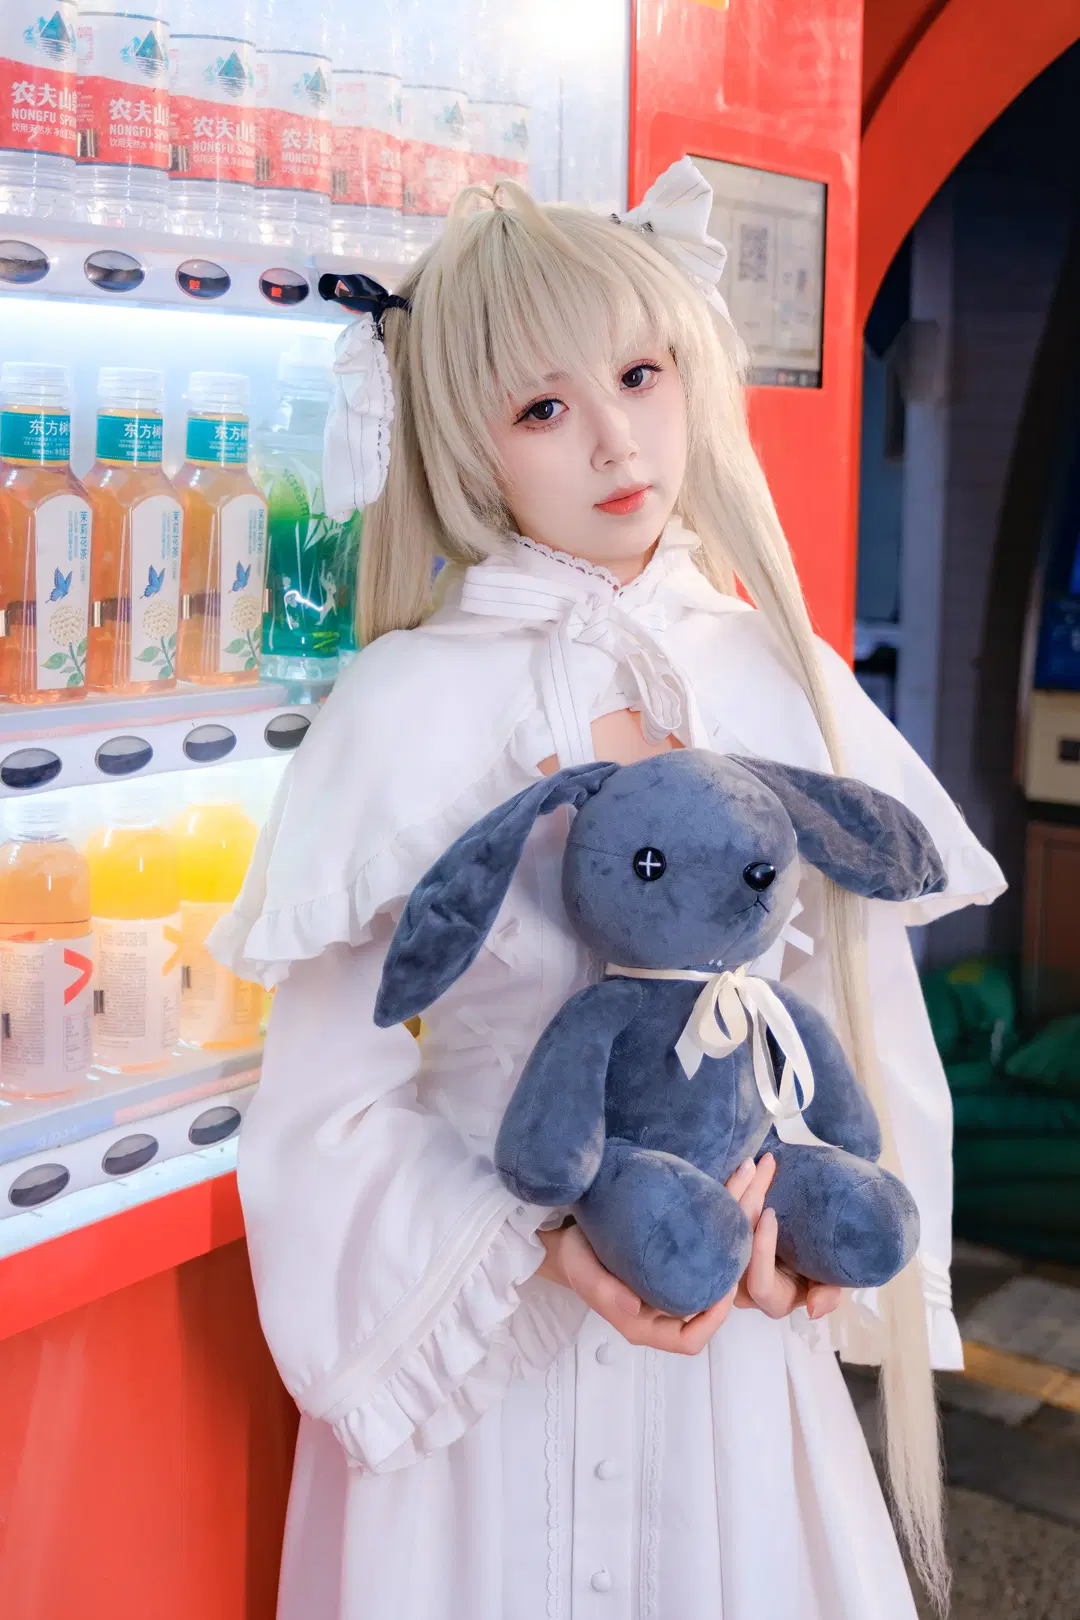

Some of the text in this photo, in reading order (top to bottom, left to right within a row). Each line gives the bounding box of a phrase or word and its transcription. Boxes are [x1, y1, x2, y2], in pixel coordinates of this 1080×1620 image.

[11, 107, 57, 124] NONGFU
[109, 97, 169, 127] 农夫山
[109, 124, 152, 139] NONGFU
[282, 126, 331, 154] 农夫山
[192, 141, 234, 155] NONGFU
[283, 468, 310, 517] scream
[80, 511, 88, 560] 茉莉花茶
